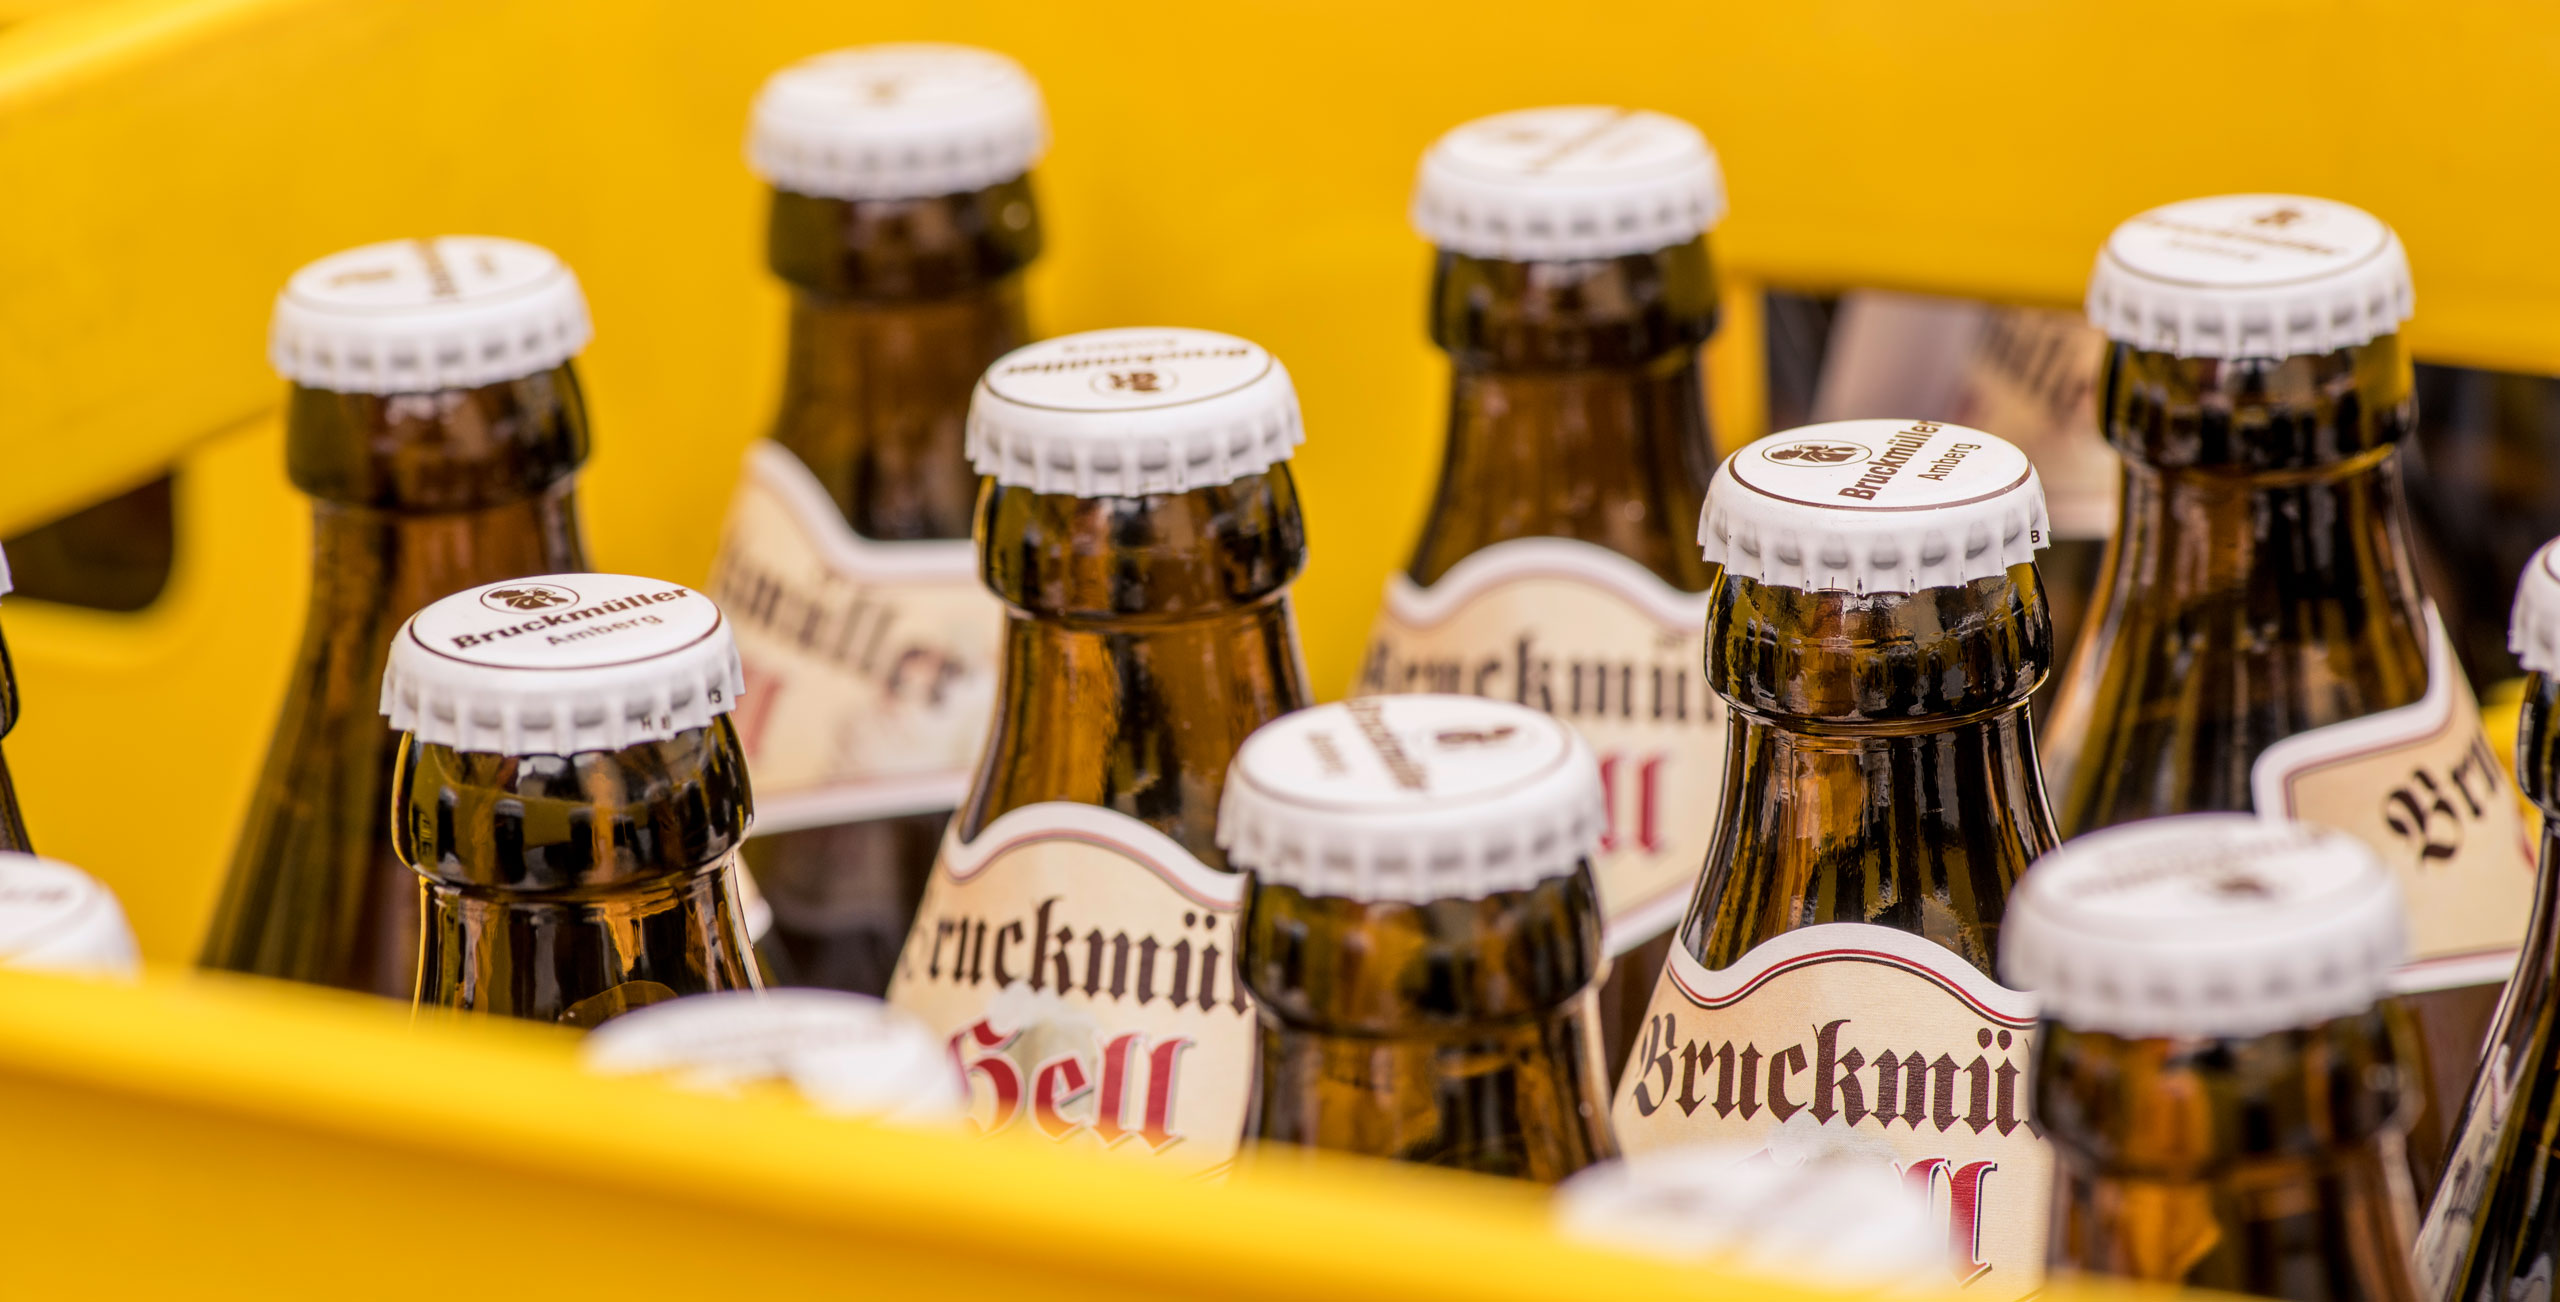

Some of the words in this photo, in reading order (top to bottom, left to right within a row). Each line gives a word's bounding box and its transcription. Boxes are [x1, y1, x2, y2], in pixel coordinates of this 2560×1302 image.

[1838, 420, 1944, 501] Bruckmüller
[1917, 442, 1982, 481] Amberg
[450, 587, 690, 650] Bruckmüller
[545, 613, 665, 646] Amberg
